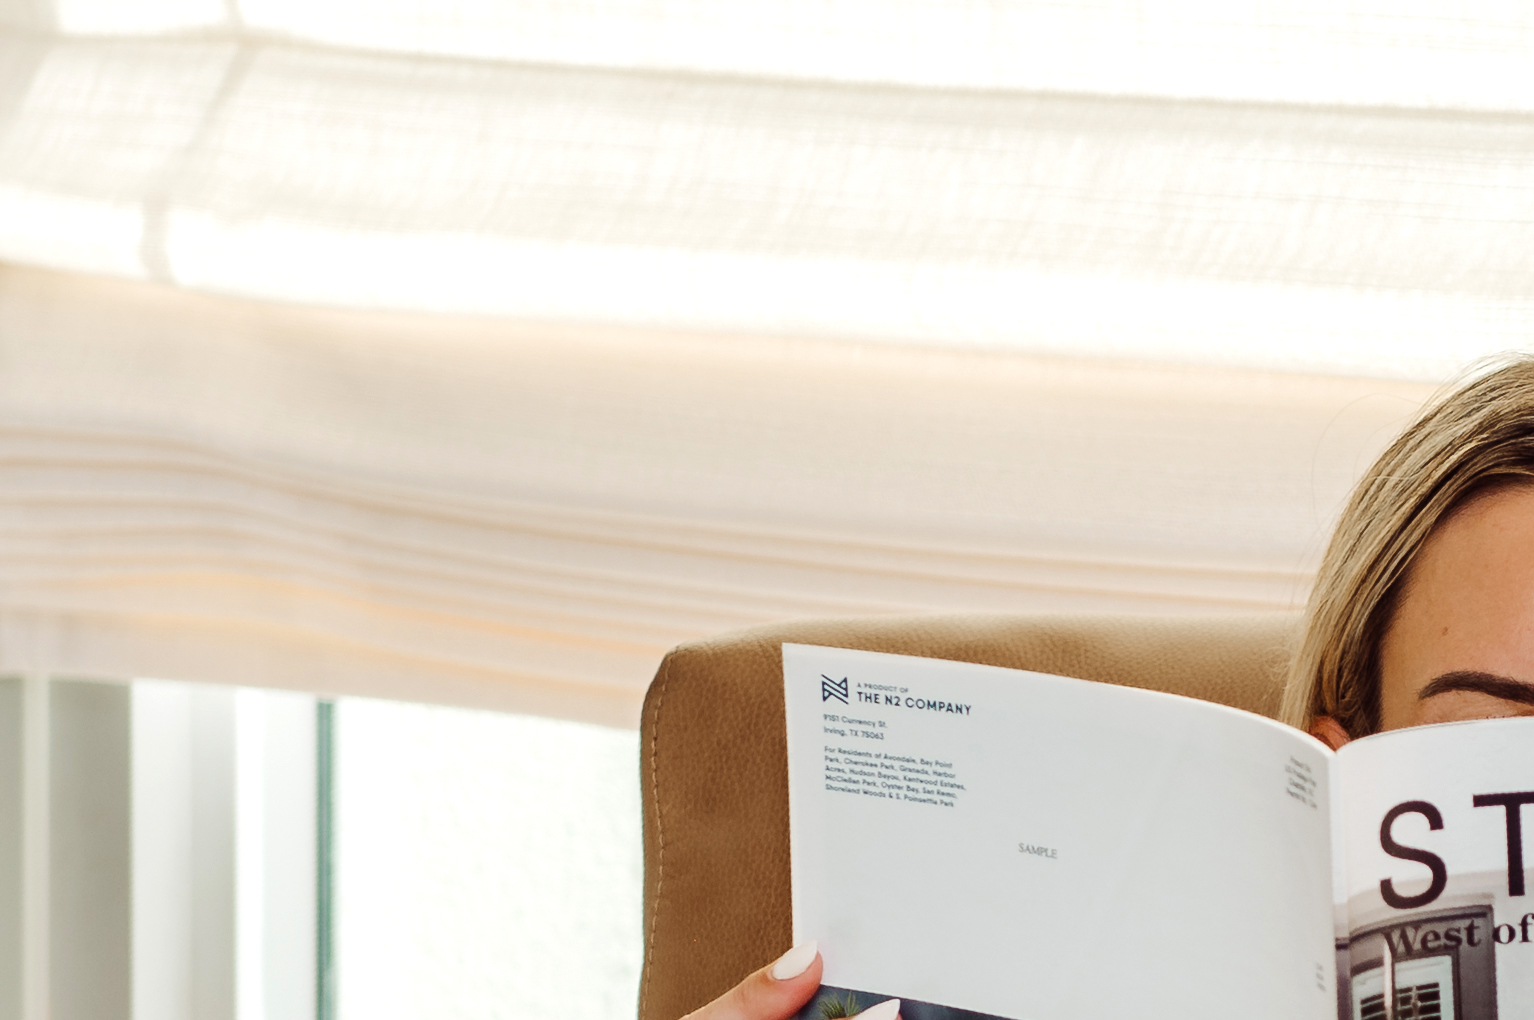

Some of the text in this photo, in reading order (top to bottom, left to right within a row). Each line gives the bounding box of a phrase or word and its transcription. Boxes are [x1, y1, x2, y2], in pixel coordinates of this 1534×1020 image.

[864, 683, 897, 692] PRODUCT
[857, 691, 972, 715] THE N2 COMPANY
[841, 716, 876, 728] Currency
[824, 726, 884, 740] Irving, TX 75063
[824, 755, 842, 764] Park,
[844, 758, 878, 769] Cherokee
[879, 762, 897, 771] Park,
[932, 770, 956, 779] Harbor
[838, 747, 872, 758] Residents
[920, 758, 933, 767] Bay
[935, 760, 953, 769] Point
[825, 765, 847, 774] Acres,
[850, 768, 876, 777] Hudson
[903, 775, 938, 786] Kentwood
[825, 783, 860, 794] Shoreland
[862, 788, 886, 799] Woods
[940, 799, 954, 808] Park
[862, 779, 879, 788] Park,
[881, 781, 904, 791] Oyster
[922, 787, 935, 795] San
[1018, 842, 1058, 859] SAMPLE
[1385, 918, 1480, 957] West
